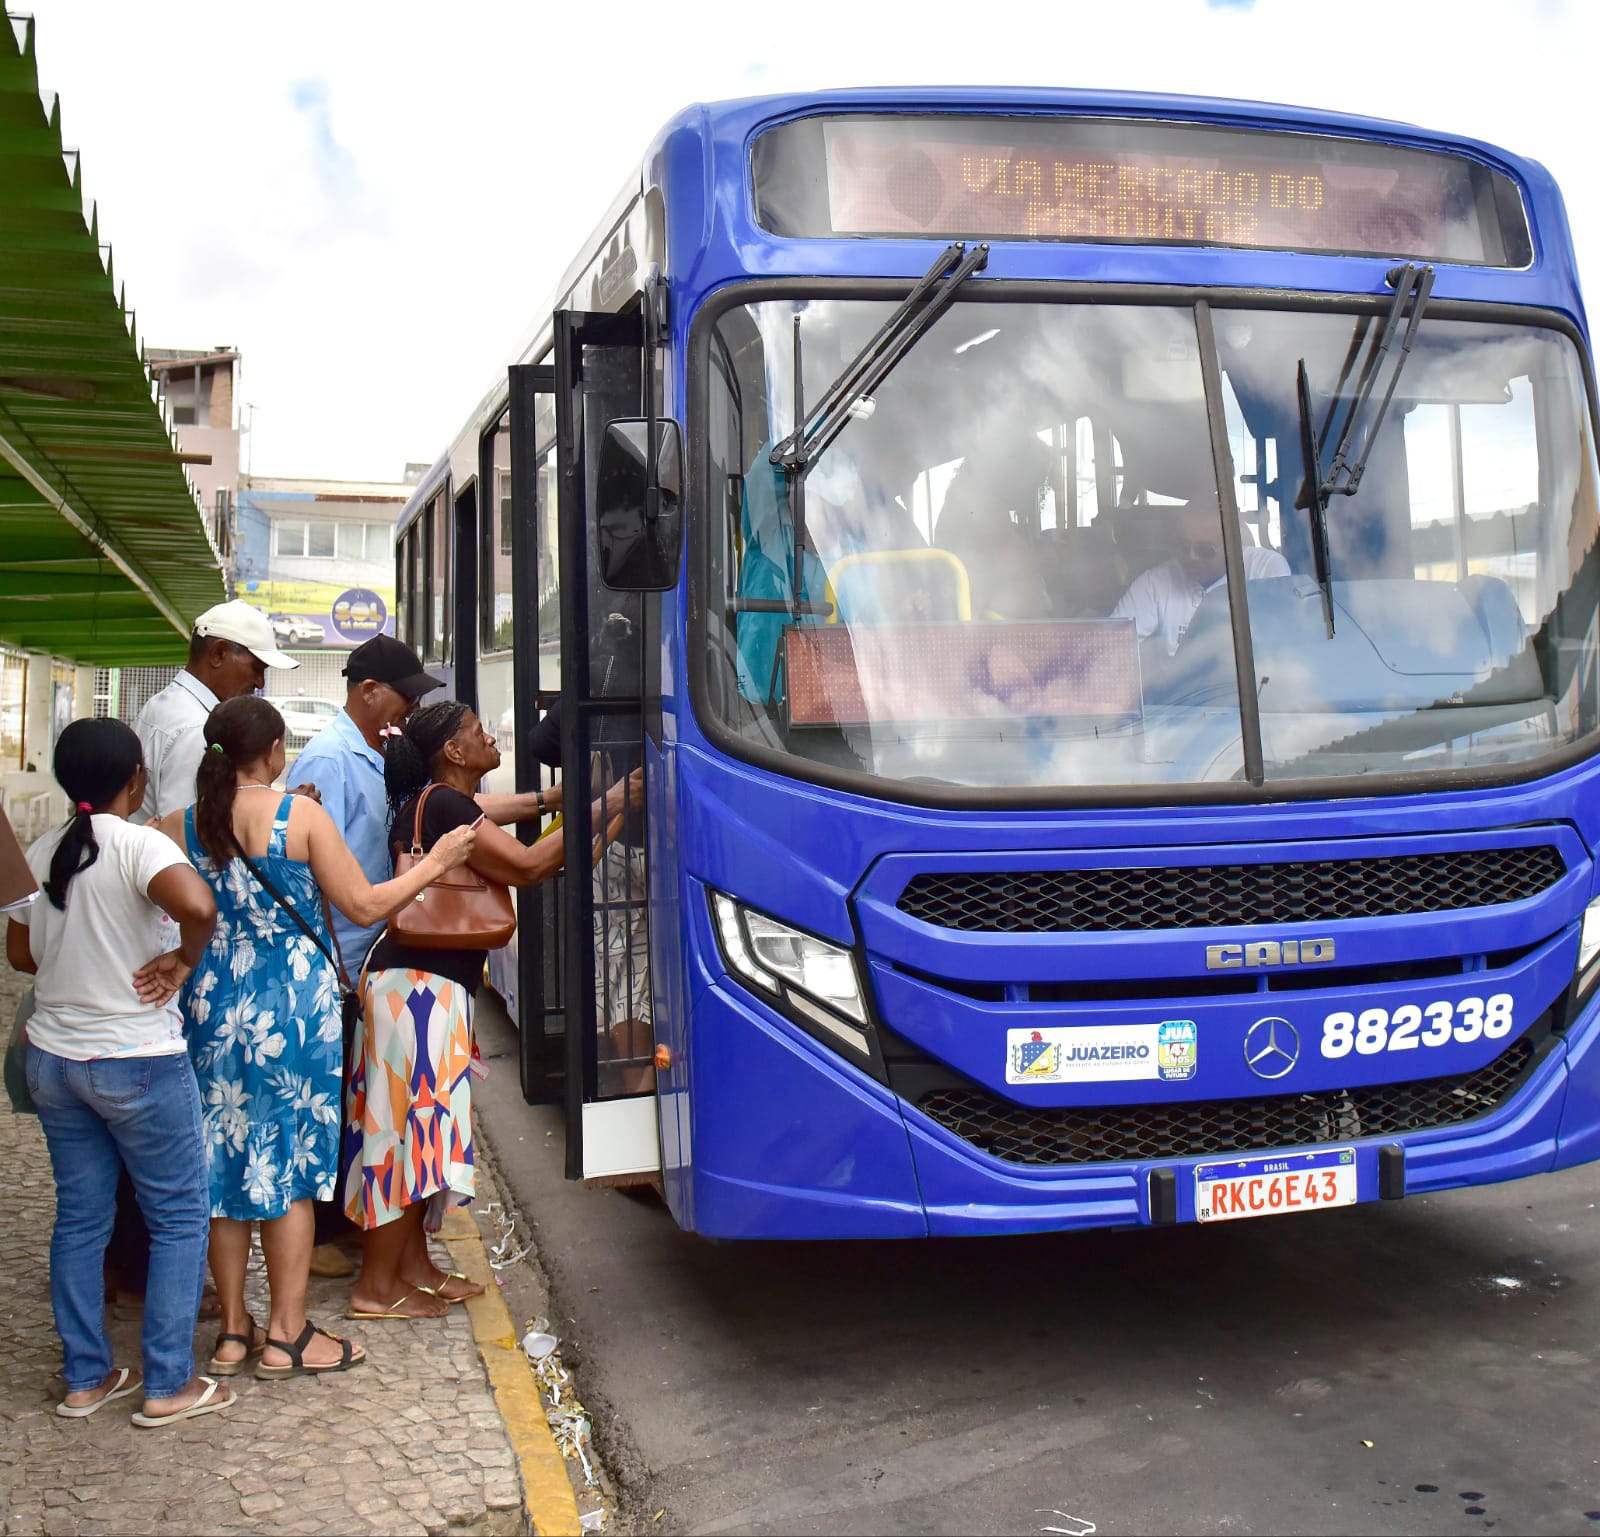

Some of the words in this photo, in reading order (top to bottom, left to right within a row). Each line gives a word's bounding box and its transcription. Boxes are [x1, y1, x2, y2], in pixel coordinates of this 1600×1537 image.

[963, 157, 1041, 195] VIA
[1054, 161, 1259, 206] MERCADO
[1270, 173, 1323, 210] DO
[335, 601, 383, 622] SOL
[1206, 938, 1335, 970] CAIO
[1320, 993, 1514, 1059] 882338
[1066, 1045, 1150, 1062] JUAZEIRO
[1263, 1162, 1290, 1173] BRASIL
[1212, 1171, 1337, 1215] RKC6E43
